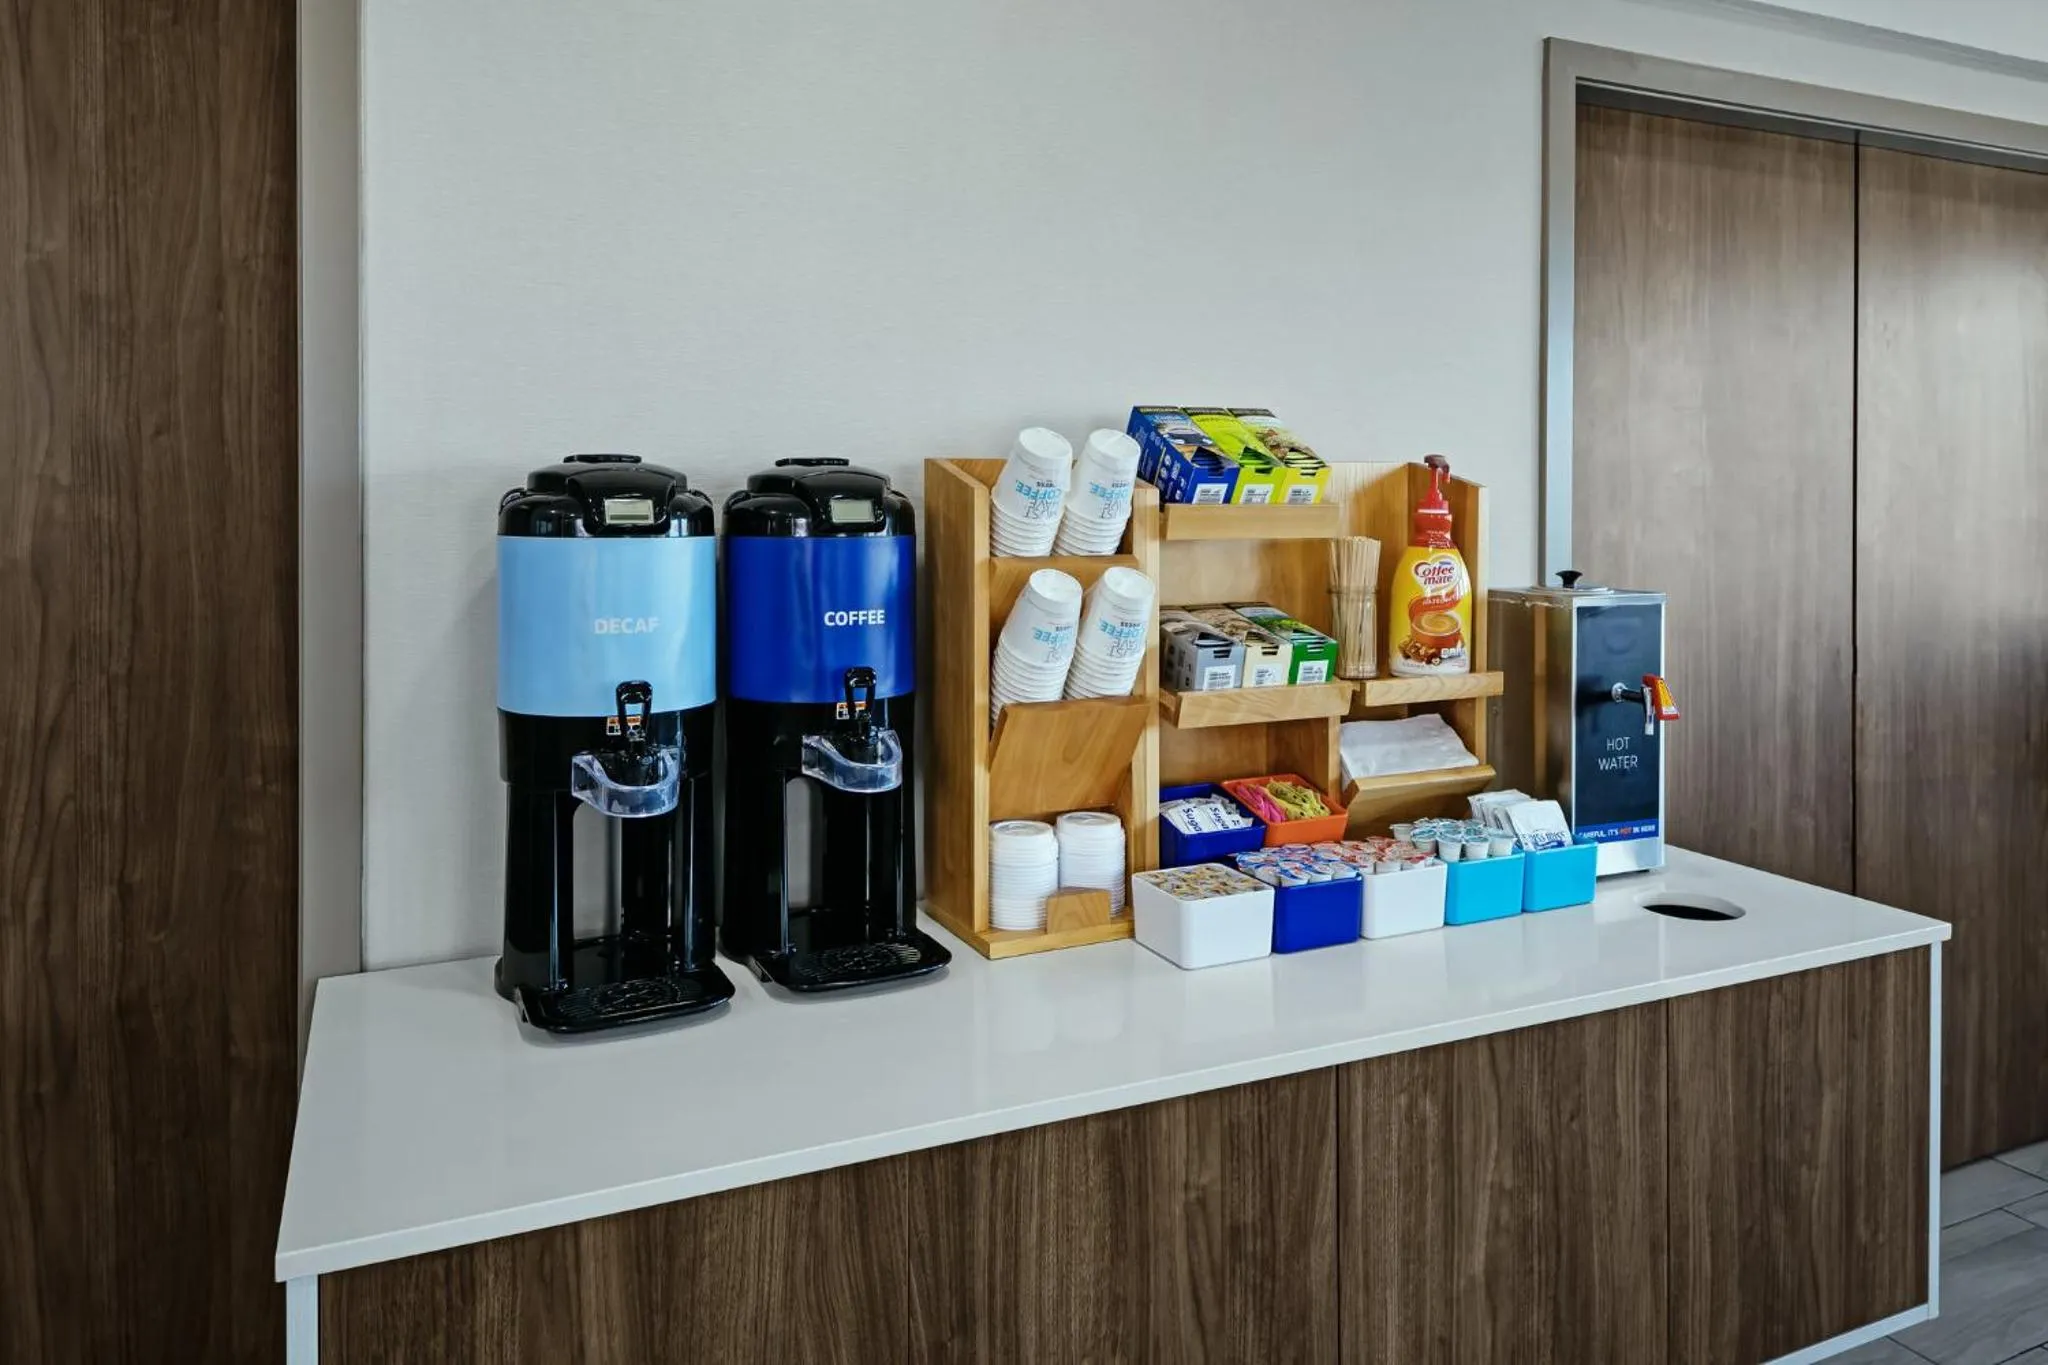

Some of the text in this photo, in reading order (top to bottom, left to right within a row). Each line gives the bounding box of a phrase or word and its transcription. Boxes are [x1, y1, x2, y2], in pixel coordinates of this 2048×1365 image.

[1414, 562, 1455, 578] Coffee
[1424, 575, 1453, 586] mate
[594, 616, 660, 634] DECAF
[824, 609, 885, 626] COFFEE
[1606, 736, 1631, 751] HOT
[1598, 754, 1639, 770] WATER
